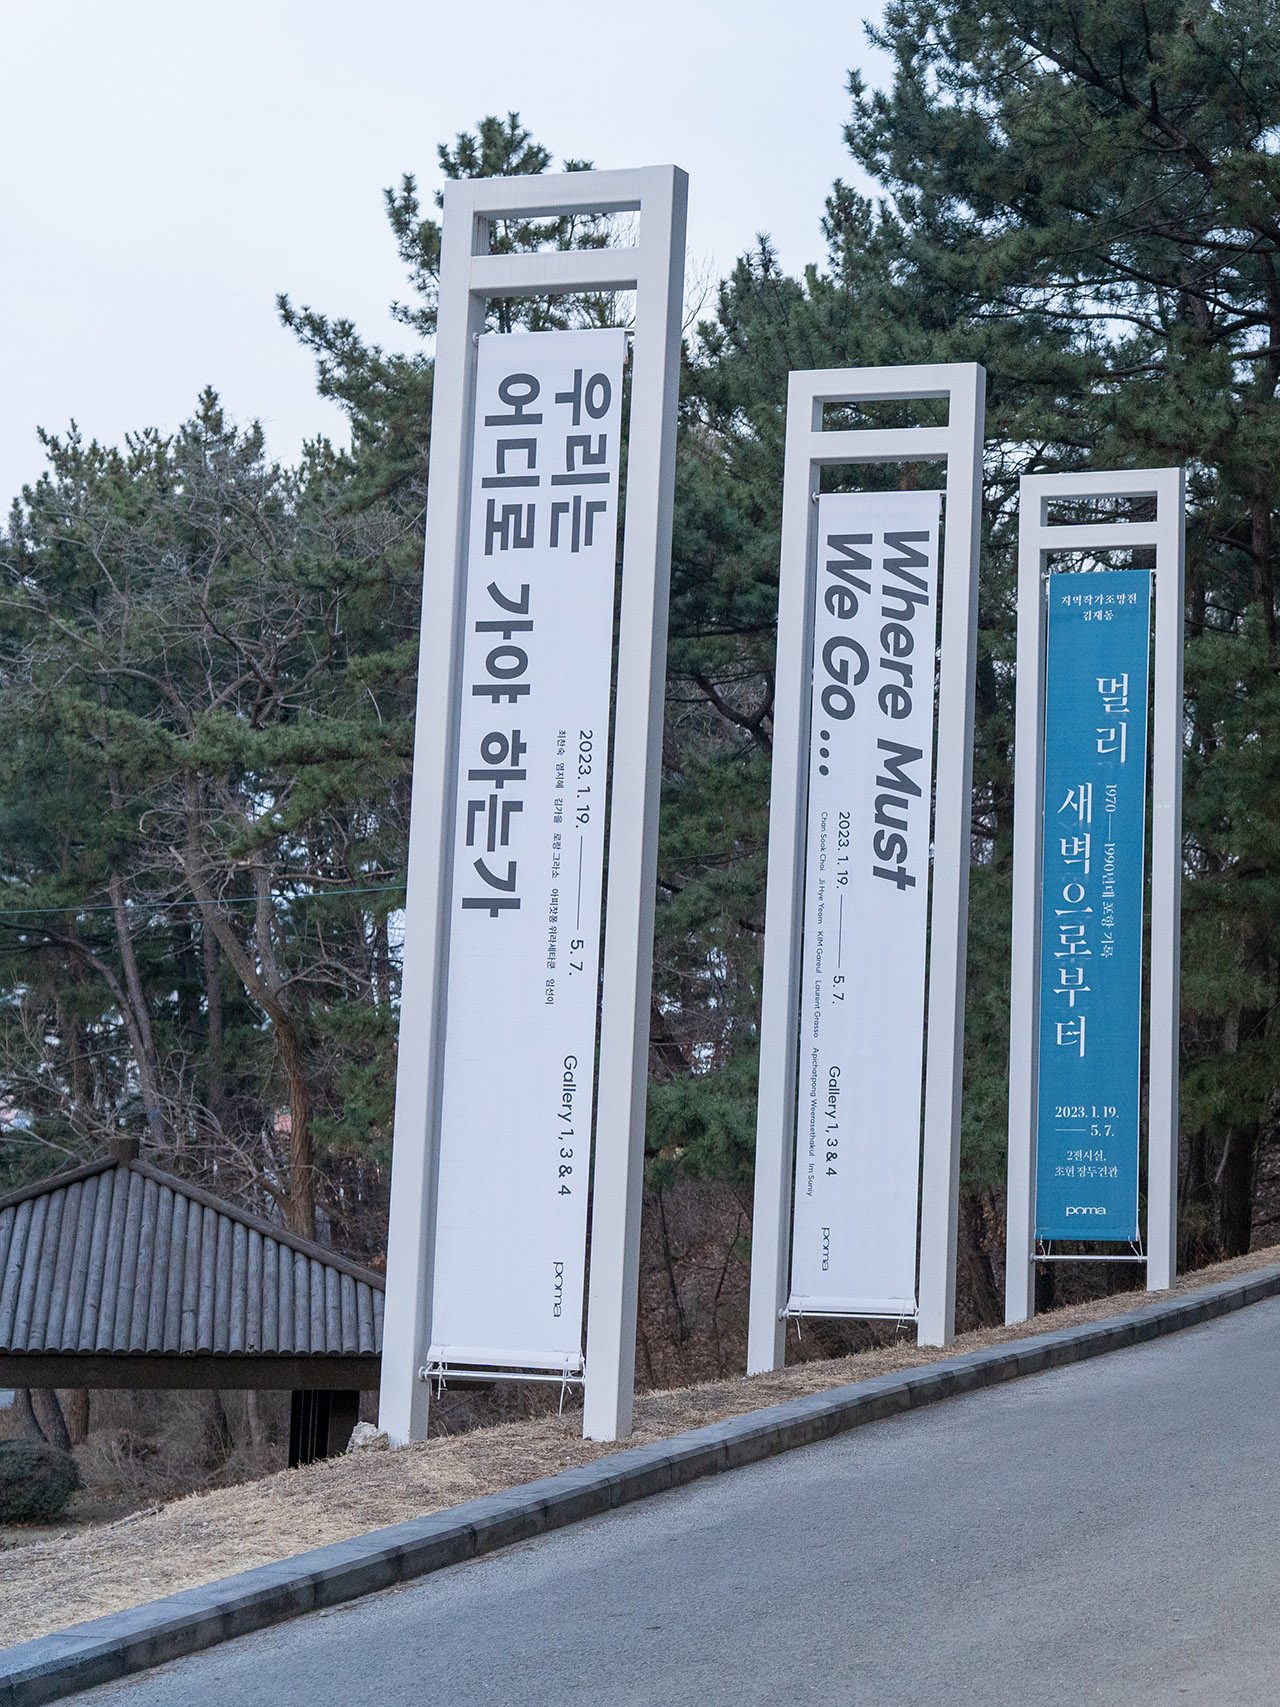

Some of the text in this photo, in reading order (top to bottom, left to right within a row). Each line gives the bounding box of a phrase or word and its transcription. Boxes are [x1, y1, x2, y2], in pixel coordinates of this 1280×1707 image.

[549, 368, 612, 554] 우리는
[824, 532, 873, 620] We
[461, 372, 543, 918] 어디로 가야 하는가
[872, 530, 930, 891] Where Must
[1096, 673, 1130, 763] 멀리
[557, 729, 567, 756] 최찬숙
[555, 762, 565, 789] 염지혜
[820, 811, 829, 832] Chan
[552, 833, 562, 851] 로랑
[569, 729, 593, 976] 2023. 1. 19. 5. 7.
[819, 833, 828, 852] Sook
[551, 852, 561, 879] 그라소
[819, 853, 827, 871] Choi
[832, 811, 851, 1004] 2023. 1. 19. 5. 7.
[1053, 782, 1094, 1058] 새벽으로부터
[1101, 901, 1115, 928] 포항
[816, 930, 824, 947] KIM
[814, 980, 822, 1009] Laurent
[813, 1010, 821, 1038] Grasso
[809, 1047, 820, 1097] Apichatpong
[557, 1055, 578, 1196] Gallery 1, 3 & 4
[808, 1099, 818, 1157] Weerasethakul
[825, 1066, 841, 1176] Gallery 1, 3 & 4
[1055, 1106, 1120, 1119] 2023. 1. 19.
[1090, 1124, 1115, 1137] 5. 7.
[1065, 1206, 1106, 1217] poma
[821, 1227, 831, 1271] poma
[552, 1261, 565, 1318] poma
